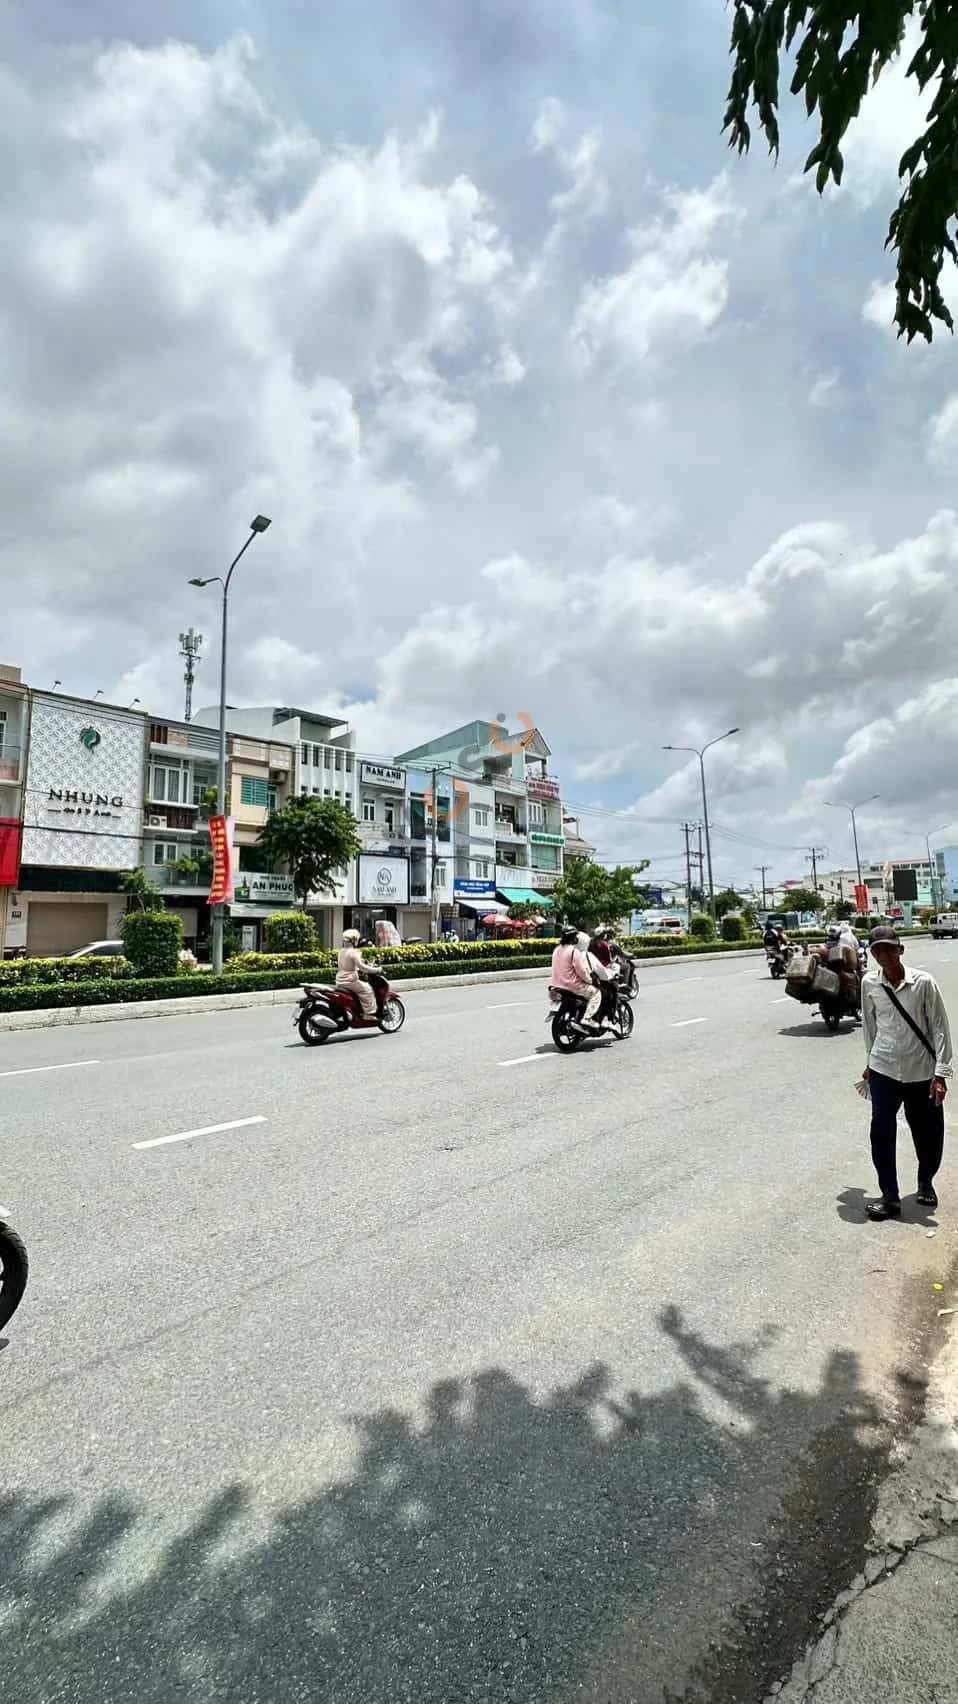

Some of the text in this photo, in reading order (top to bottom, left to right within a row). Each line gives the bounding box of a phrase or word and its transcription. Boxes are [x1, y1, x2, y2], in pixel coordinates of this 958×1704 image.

[366, 766, 401, 780] NAM ANH
[48, 788, 123, 808] NHUNG
[252, 881, 266, 890] AN
